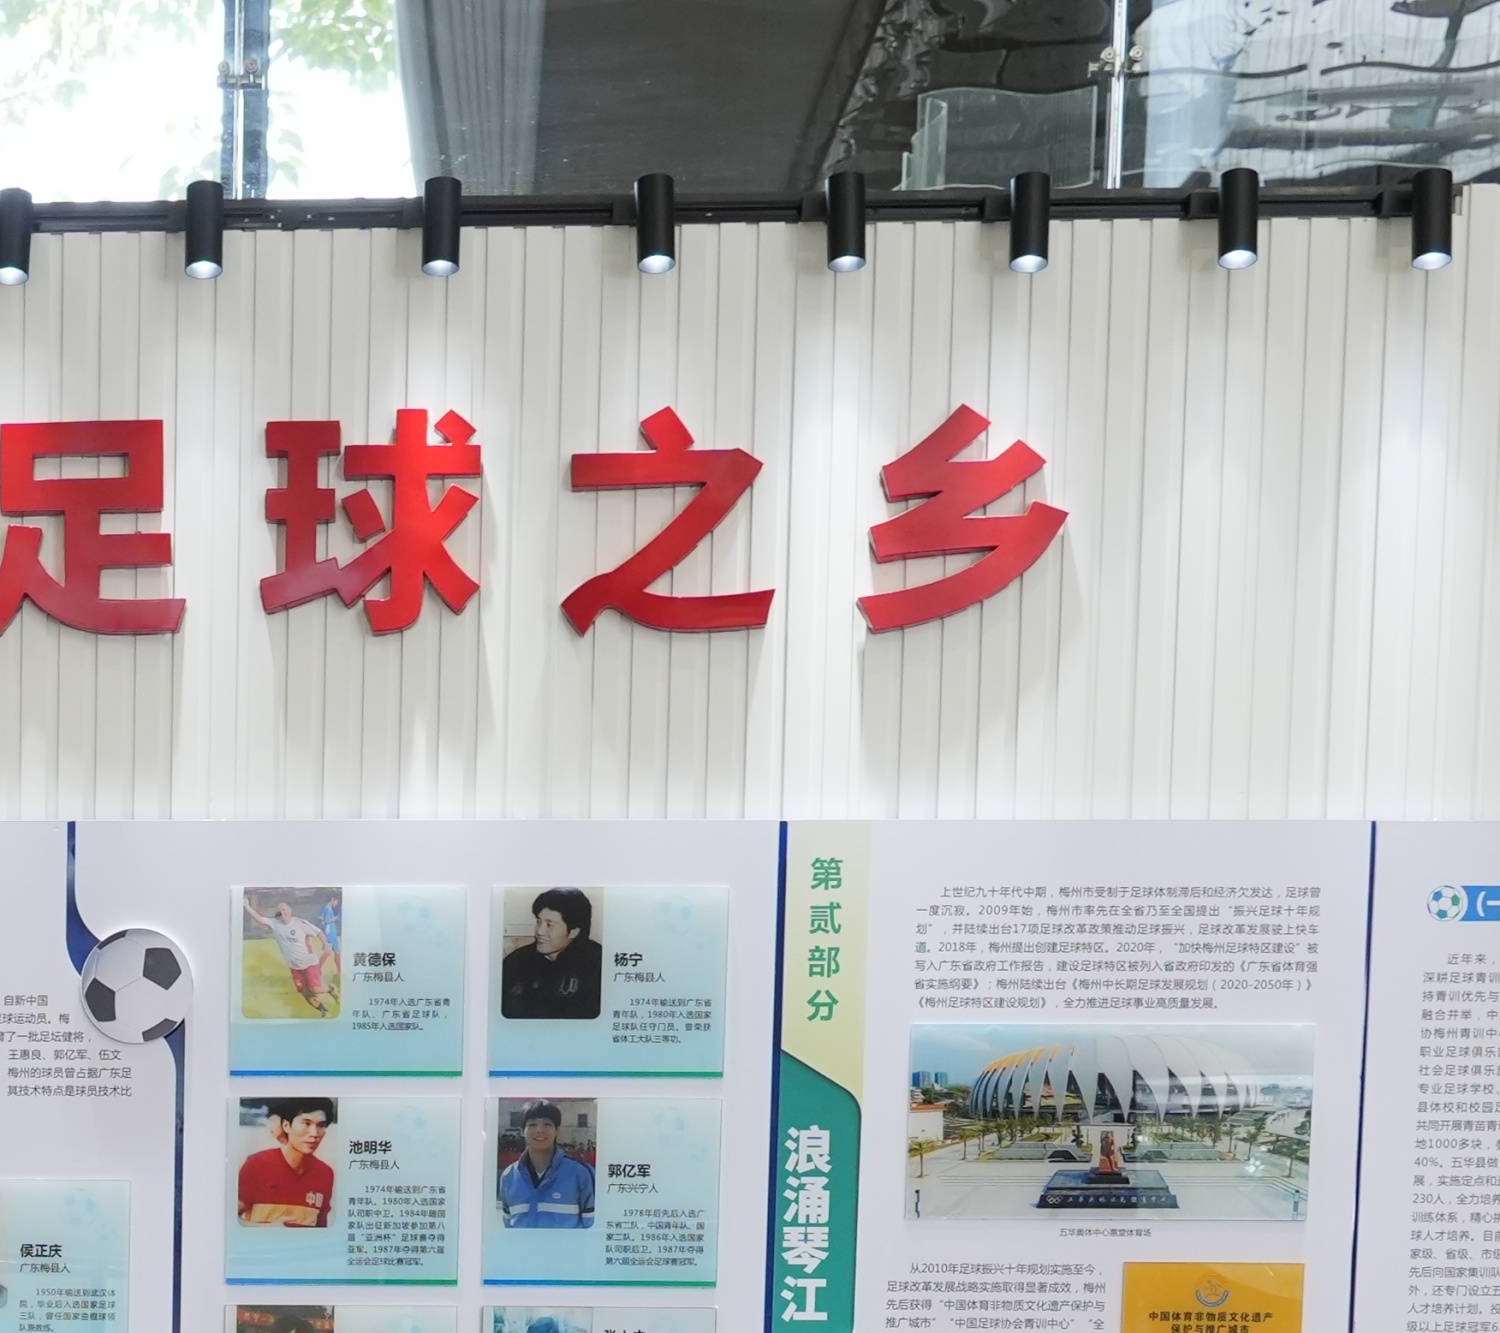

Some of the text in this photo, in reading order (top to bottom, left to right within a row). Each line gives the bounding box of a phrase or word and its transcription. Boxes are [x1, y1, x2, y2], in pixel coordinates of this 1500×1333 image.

[806, 856, 844, 1022] 第贰部分
[353, 952, 396, 967] 黄德保
[614, 952, 643, 967] 杨宁
[352, 971, 405, 983] 广东梅县人
[613, 972, 665, 983] 广东梅县人
[349, 1140, 392, 1155] 池明华
[349, 1160, 400, 1170] 广东梅县人
[607, 1164, 651, 1178] 郭亿军
[607, 1183, 658, 1193] 广东兴宁人
[779, 1125, 832, 1323] 浪涌琴江
[20, 1263, 70, 1273] 广东梅县人
[1148, 1311, 1273, 1323] 中国体育非物质文化遗产
[1171, 1324, 1250, 1333] 保护与推广城市
